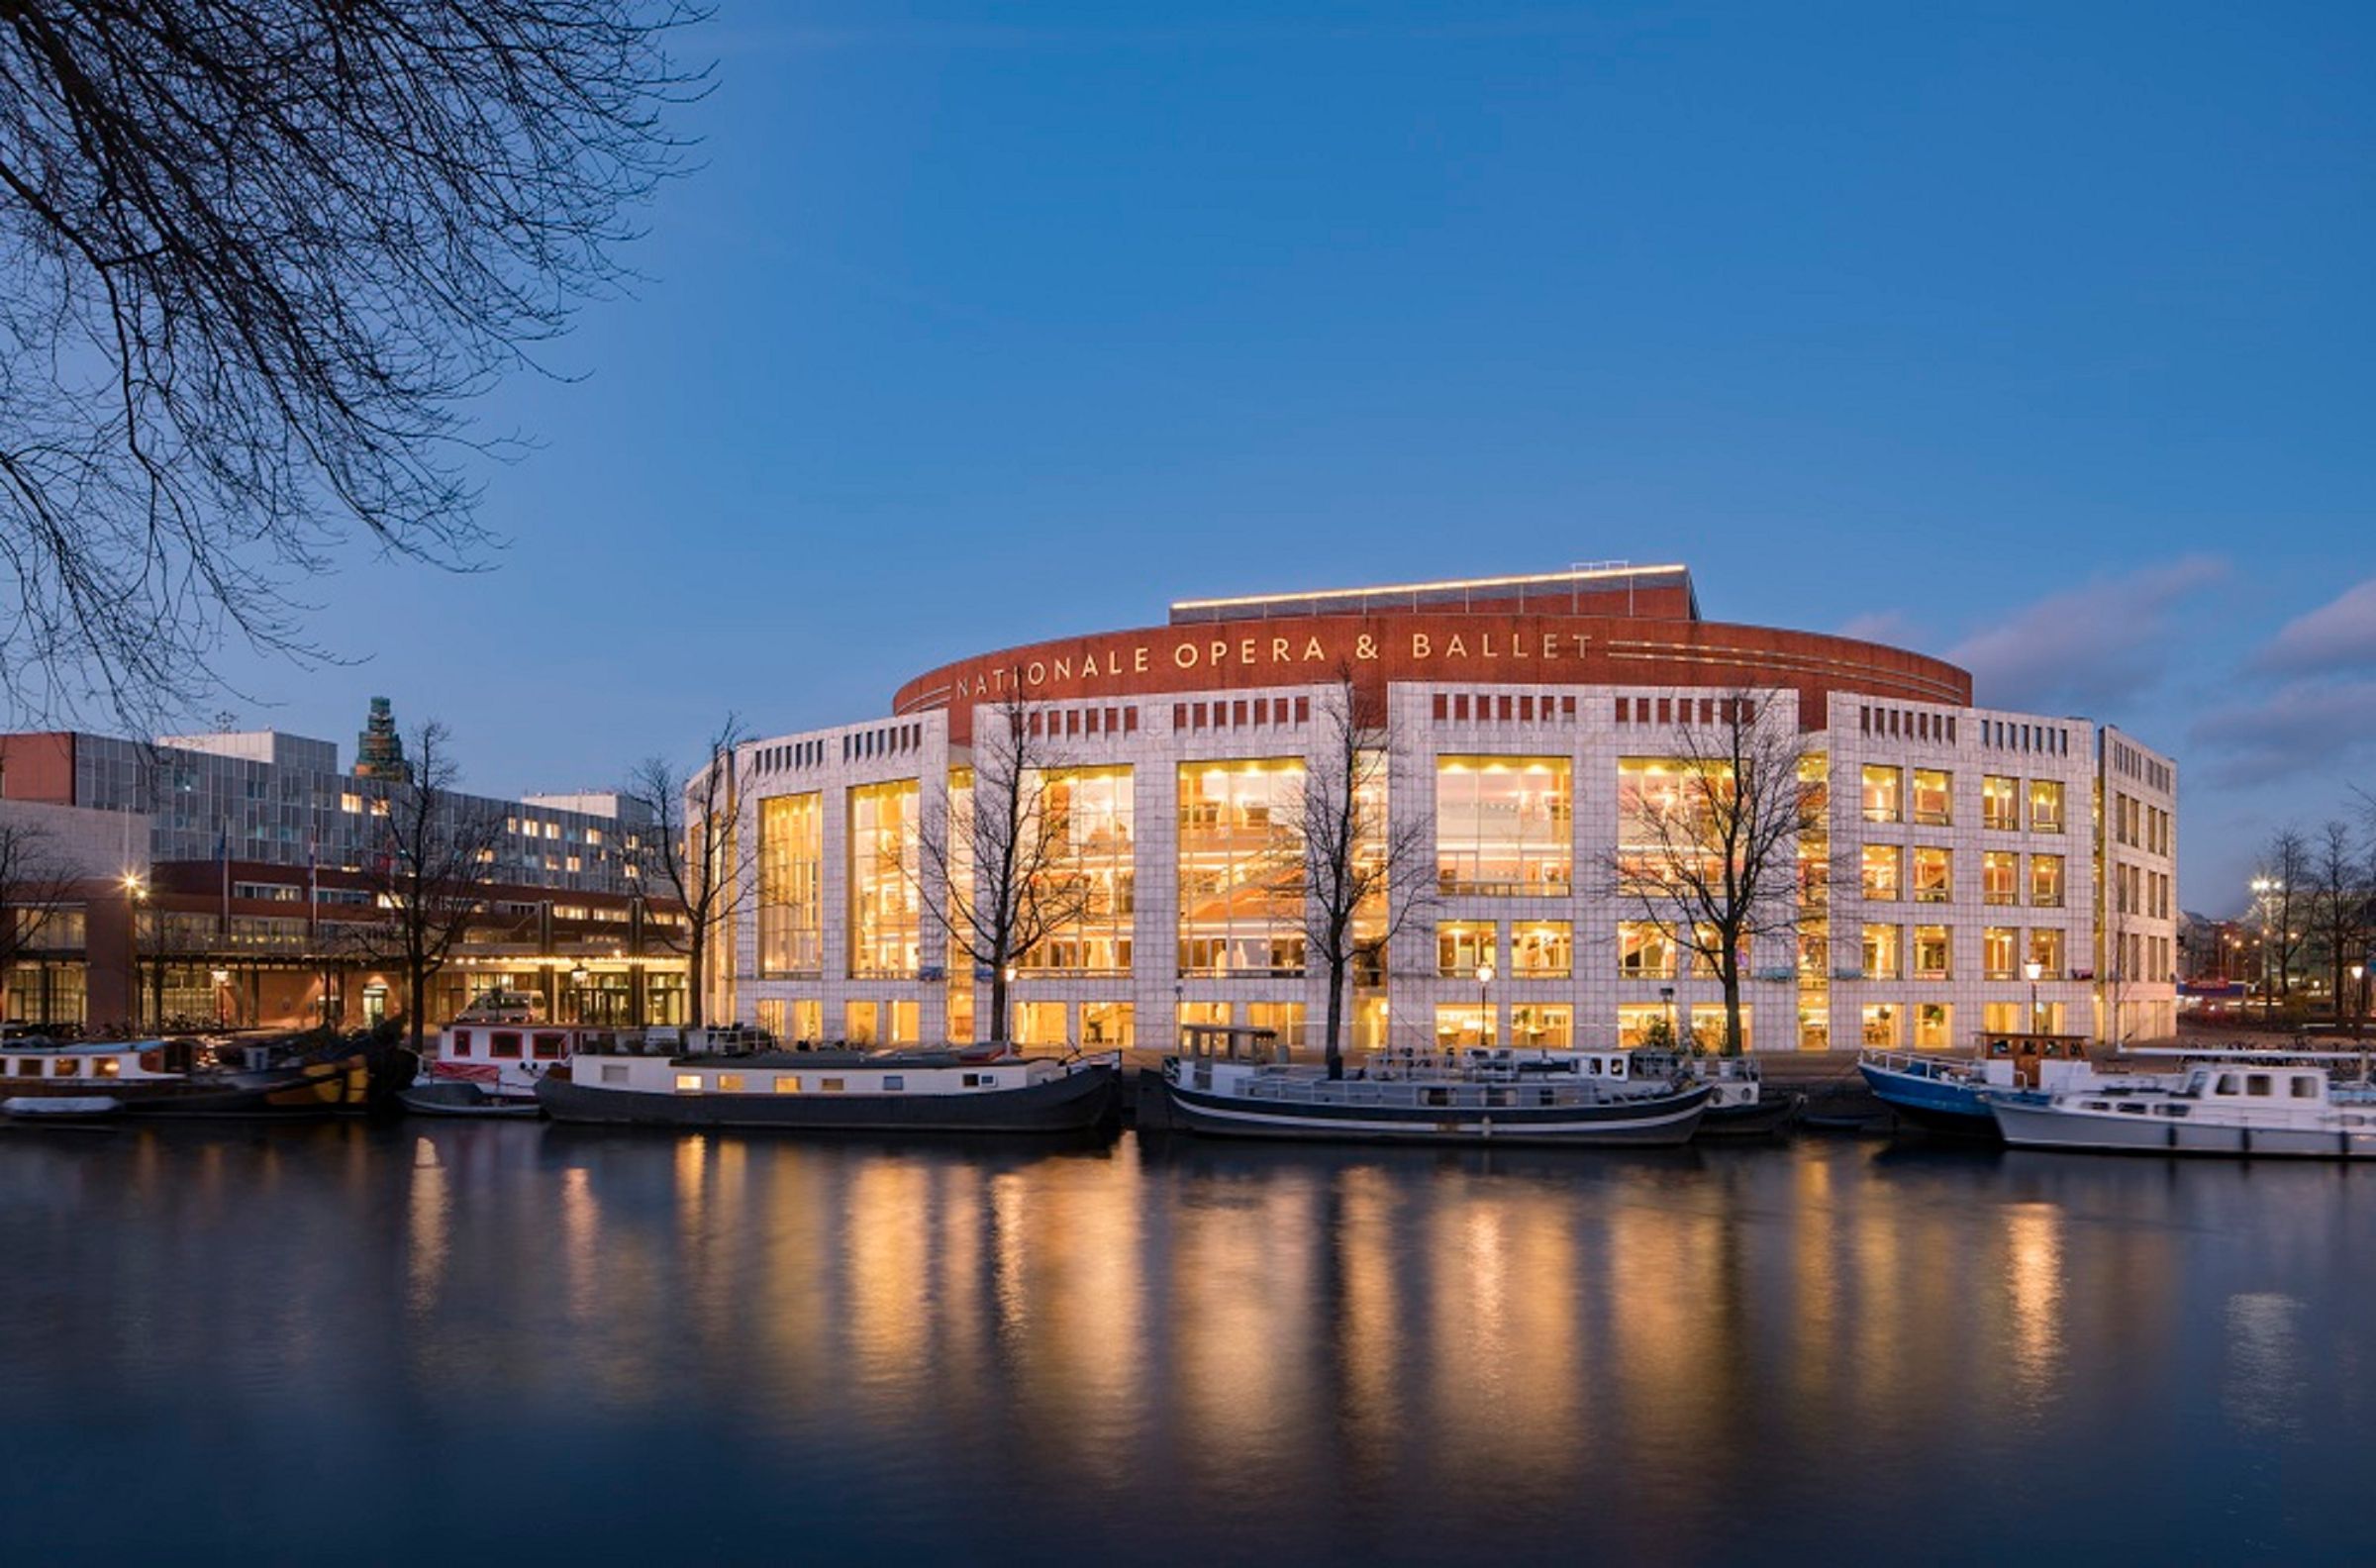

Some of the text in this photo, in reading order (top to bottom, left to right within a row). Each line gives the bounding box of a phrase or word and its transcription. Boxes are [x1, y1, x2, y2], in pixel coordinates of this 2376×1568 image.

[956, 633, 1592, 699] NATIONALE OPERA & BALLET
